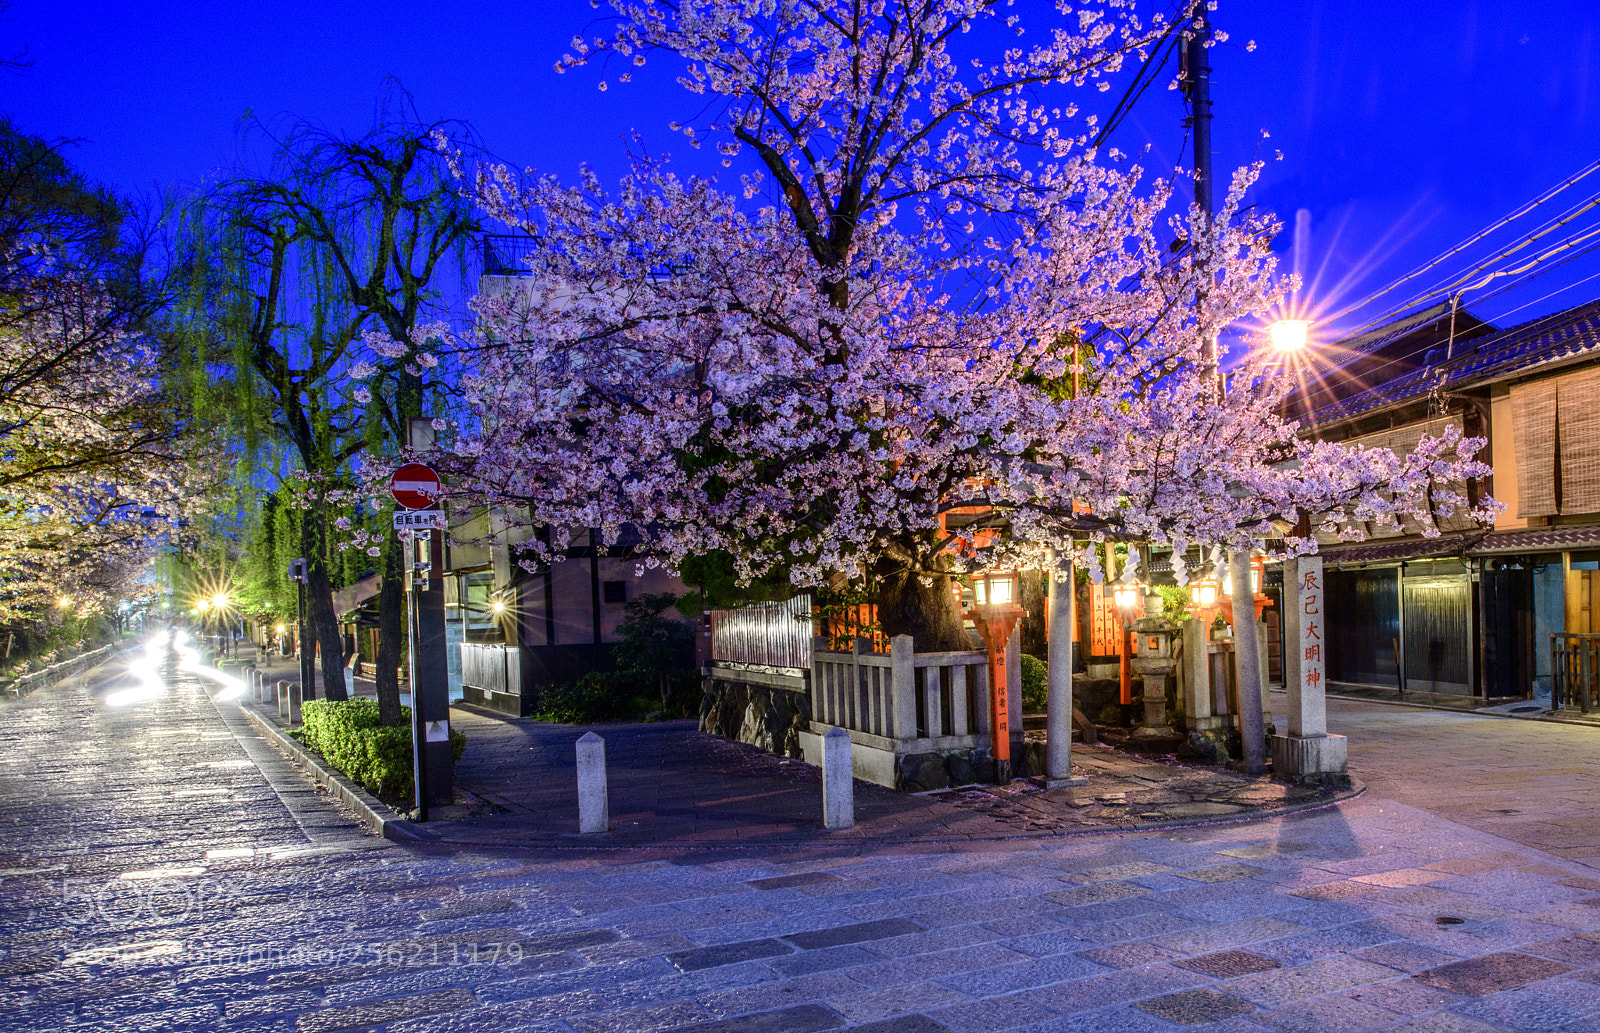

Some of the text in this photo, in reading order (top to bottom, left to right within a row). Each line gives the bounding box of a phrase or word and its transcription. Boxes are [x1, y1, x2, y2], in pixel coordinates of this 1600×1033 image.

[396, 515, 441, 525] 自転車を除
